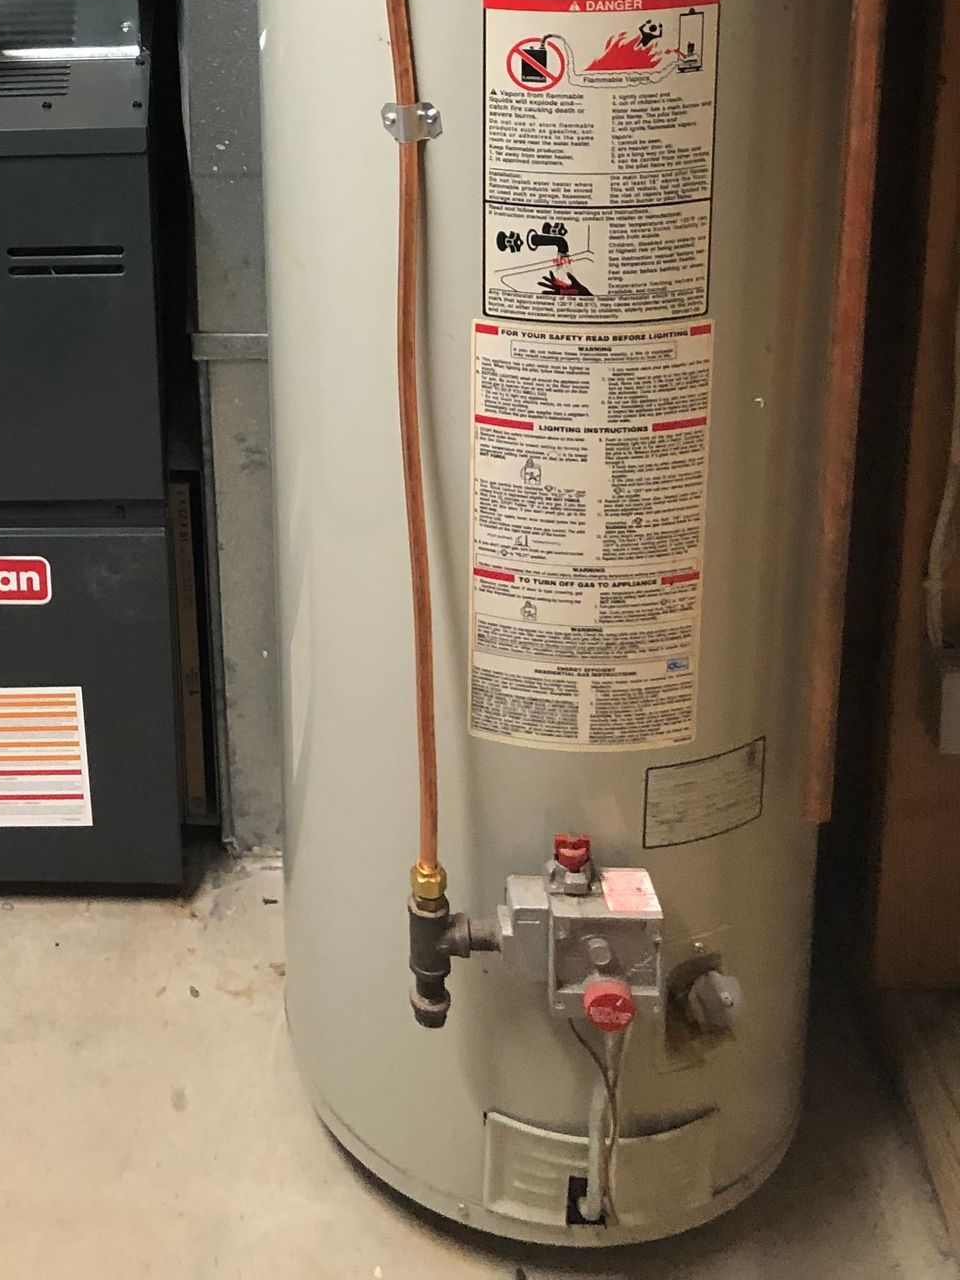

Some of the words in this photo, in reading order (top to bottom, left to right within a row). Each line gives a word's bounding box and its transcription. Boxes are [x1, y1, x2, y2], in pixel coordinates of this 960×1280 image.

[586, 0, 642, 10] DANGER
[501, 329, 518, 337] FOR
[521, 331, 546, 340] YOUR
[549, 333, 582, 342] SAFETY
[586, 334, 609, 342] READ
[612, 333, 646, 341] BEFORE
[649, 330, 688, 340] LIGHTING
[539, 425, 581, 433] LIGHTING
[584, 425, 648, 433] INSTRUCTIONS
[533, 578, 557, 586] TURN
[611, 579, 657, 587] APPLIANCE
